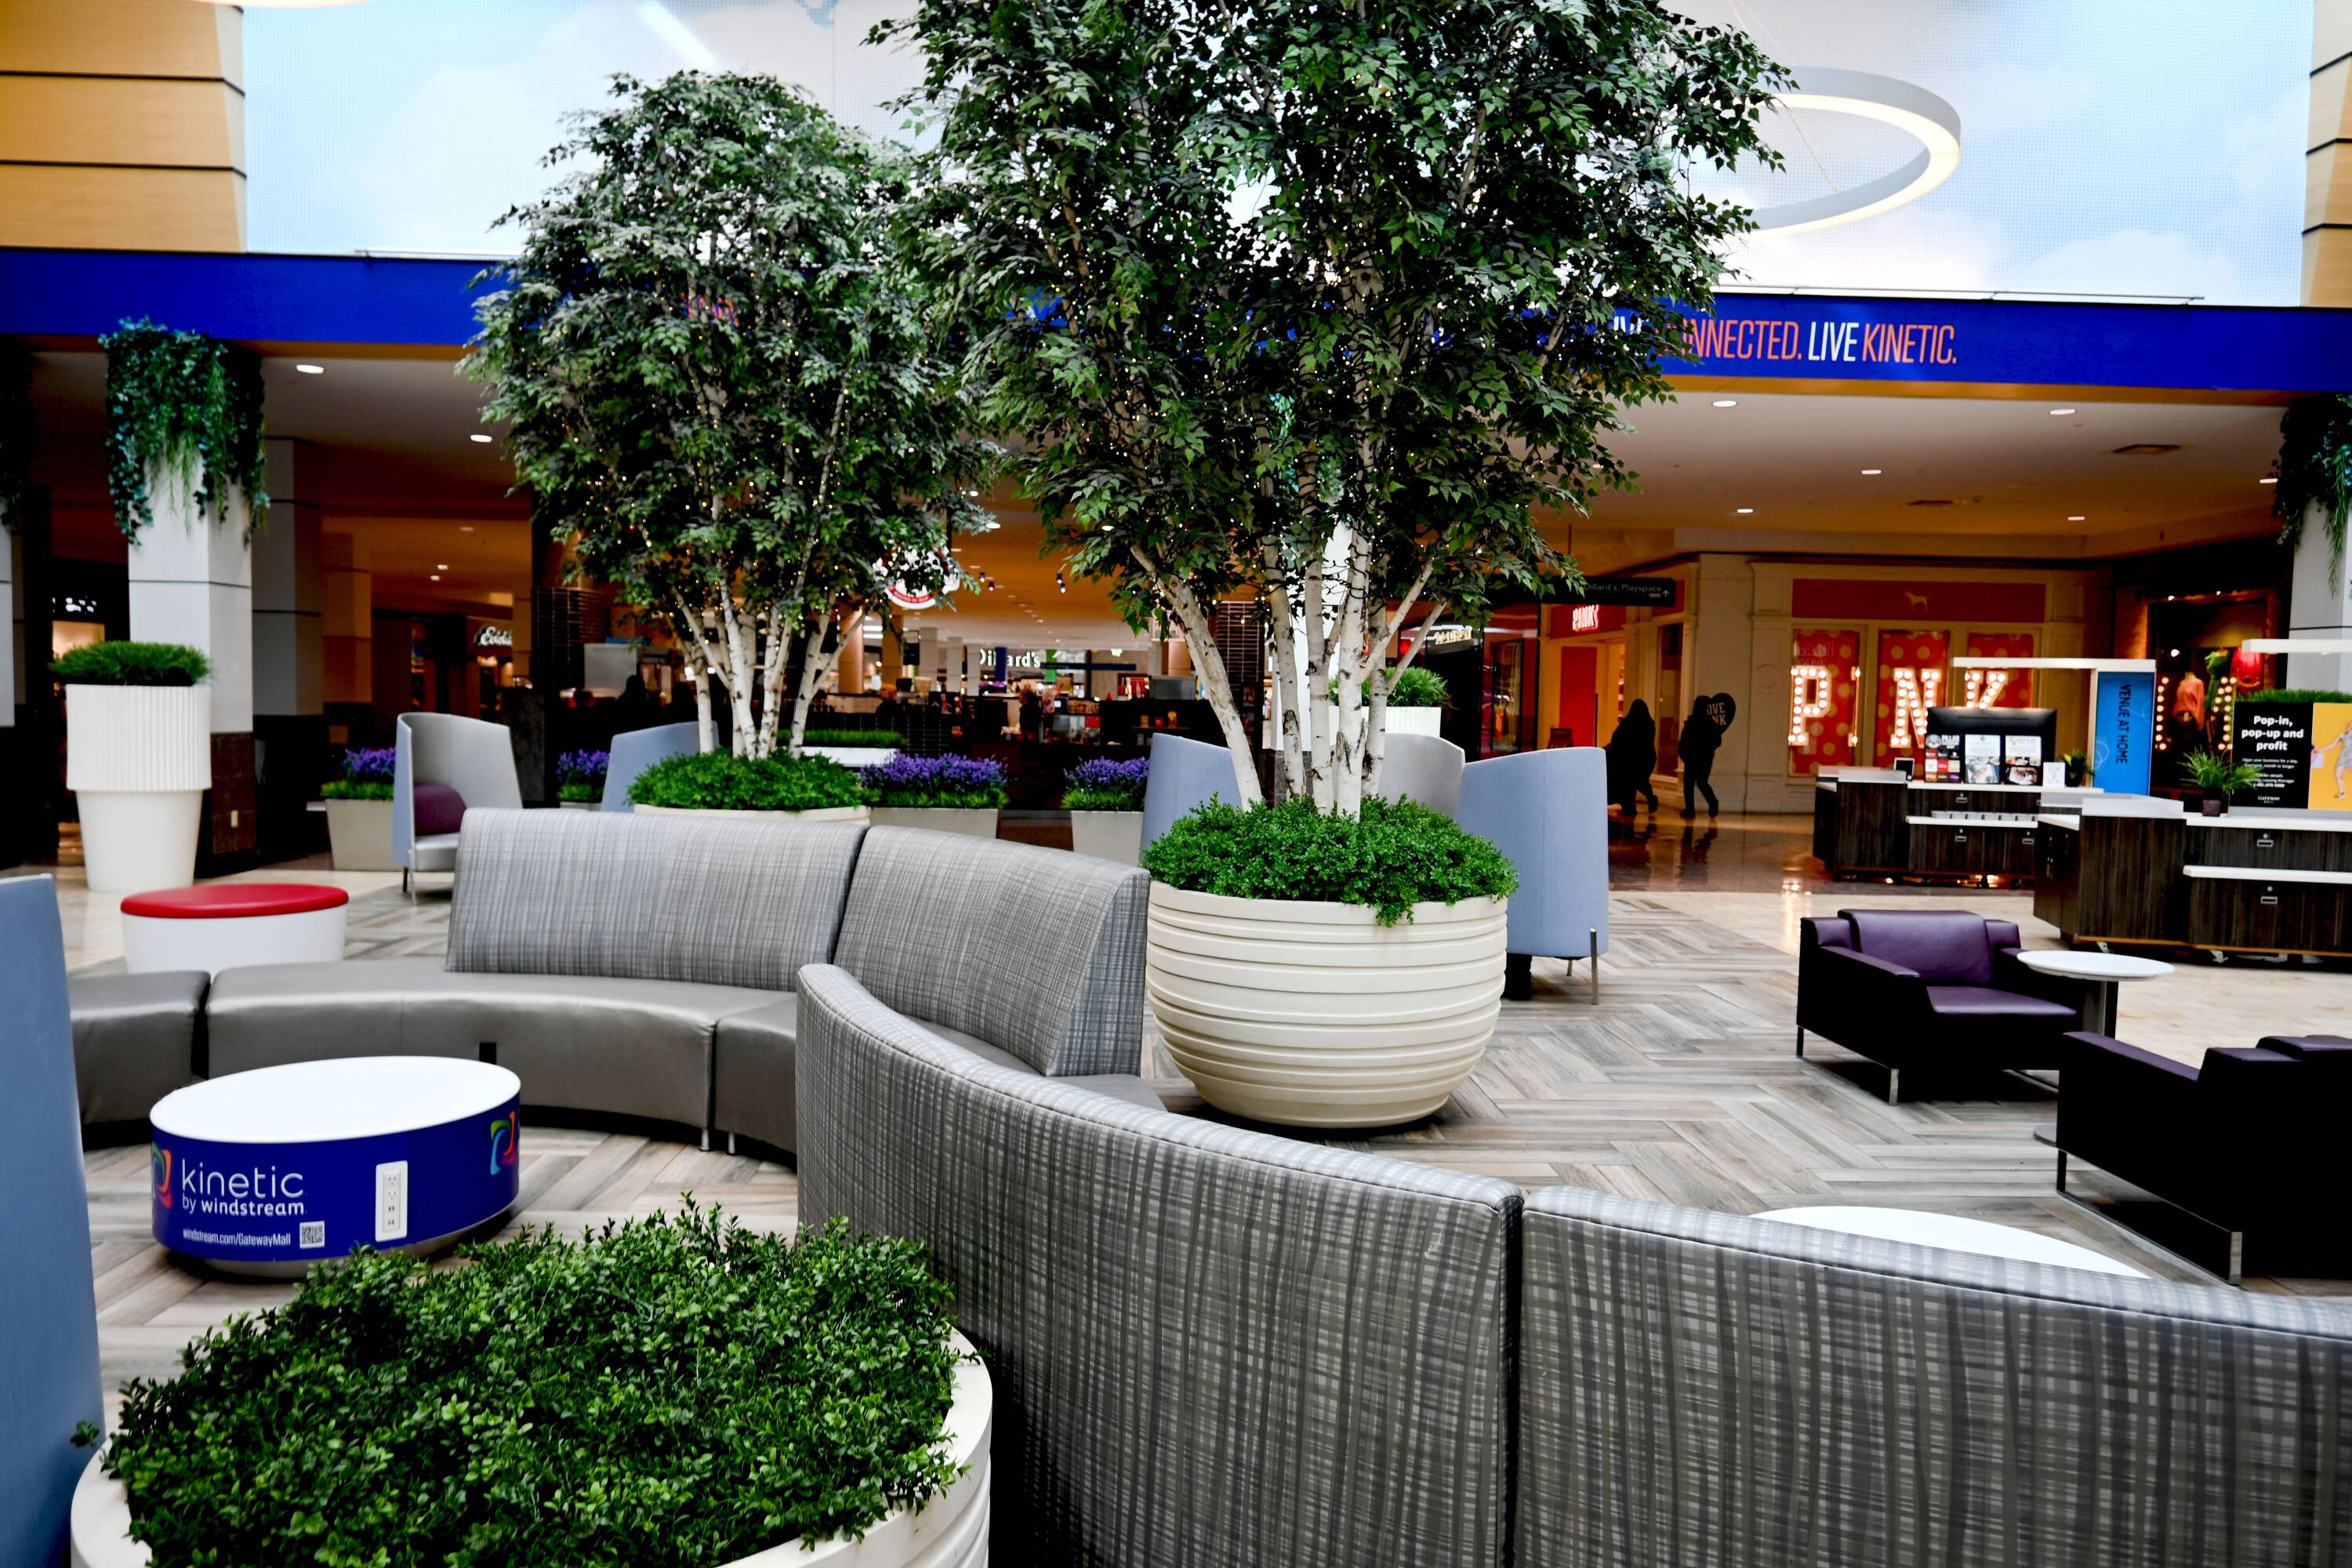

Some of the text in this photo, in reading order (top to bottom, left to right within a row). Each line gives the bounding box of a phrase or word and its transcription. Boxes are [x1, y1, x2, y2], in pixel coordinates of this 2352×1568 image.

[1808, 321, 1859, 361] LIVE
[1862, 322, 1957, 364] KINETIC.
[1621, 583, 1662, 593] Playspace
[1706, 702, 1725, 715] OVE
[2116, 684, 2132, 764] VENUE AT HOME
[2253, 715, 2293, 728] Pop-in,
[2241, 728, 2304, 740] pop-up and
[2256, 740, 2288, 753] profit
[182, 1158, 304, 1199] kinetic
[182, 1192, 305, 1216] by windstream
[183, 1228, 292, 1247] windstream.com/GatewayMall
